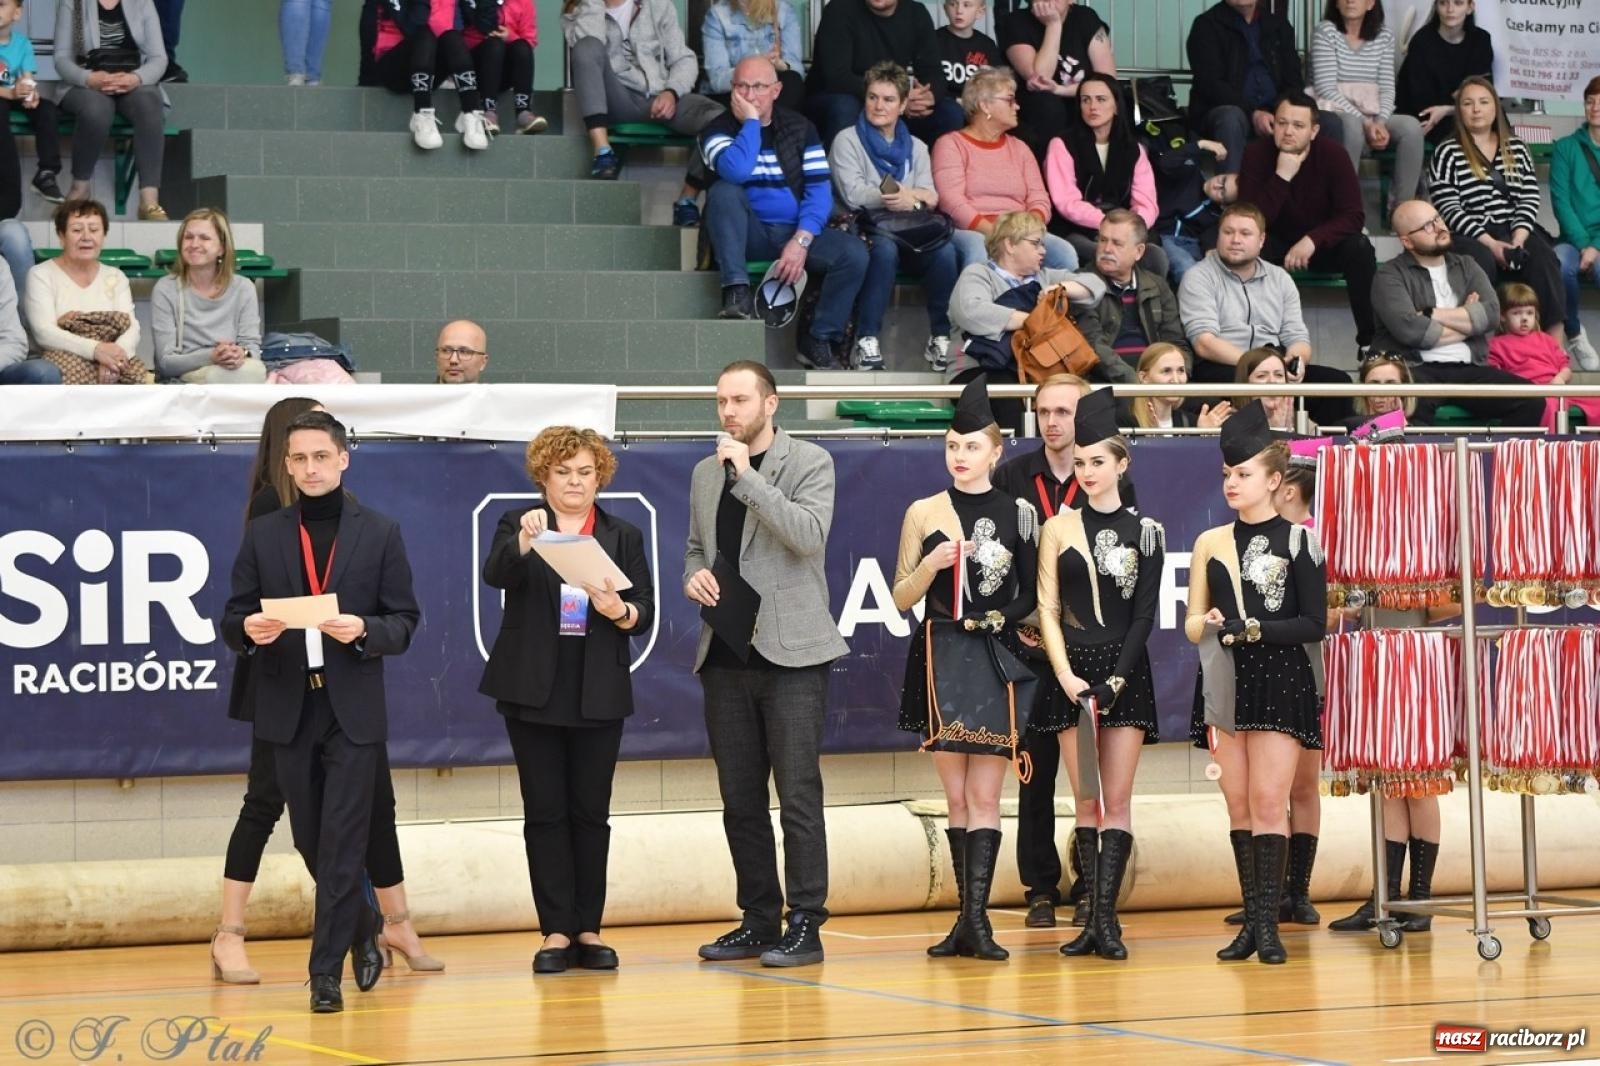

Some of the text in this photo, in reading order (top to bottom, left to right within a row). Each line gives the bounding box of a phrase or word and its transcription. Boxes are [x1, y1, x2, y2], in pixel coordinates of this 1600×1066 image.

[1505, 18, 1600, 36] Czekamy na Ci
[940, 60, 993, 84] BOS
[13, 650, 218, 694] RACIBÓRZ
